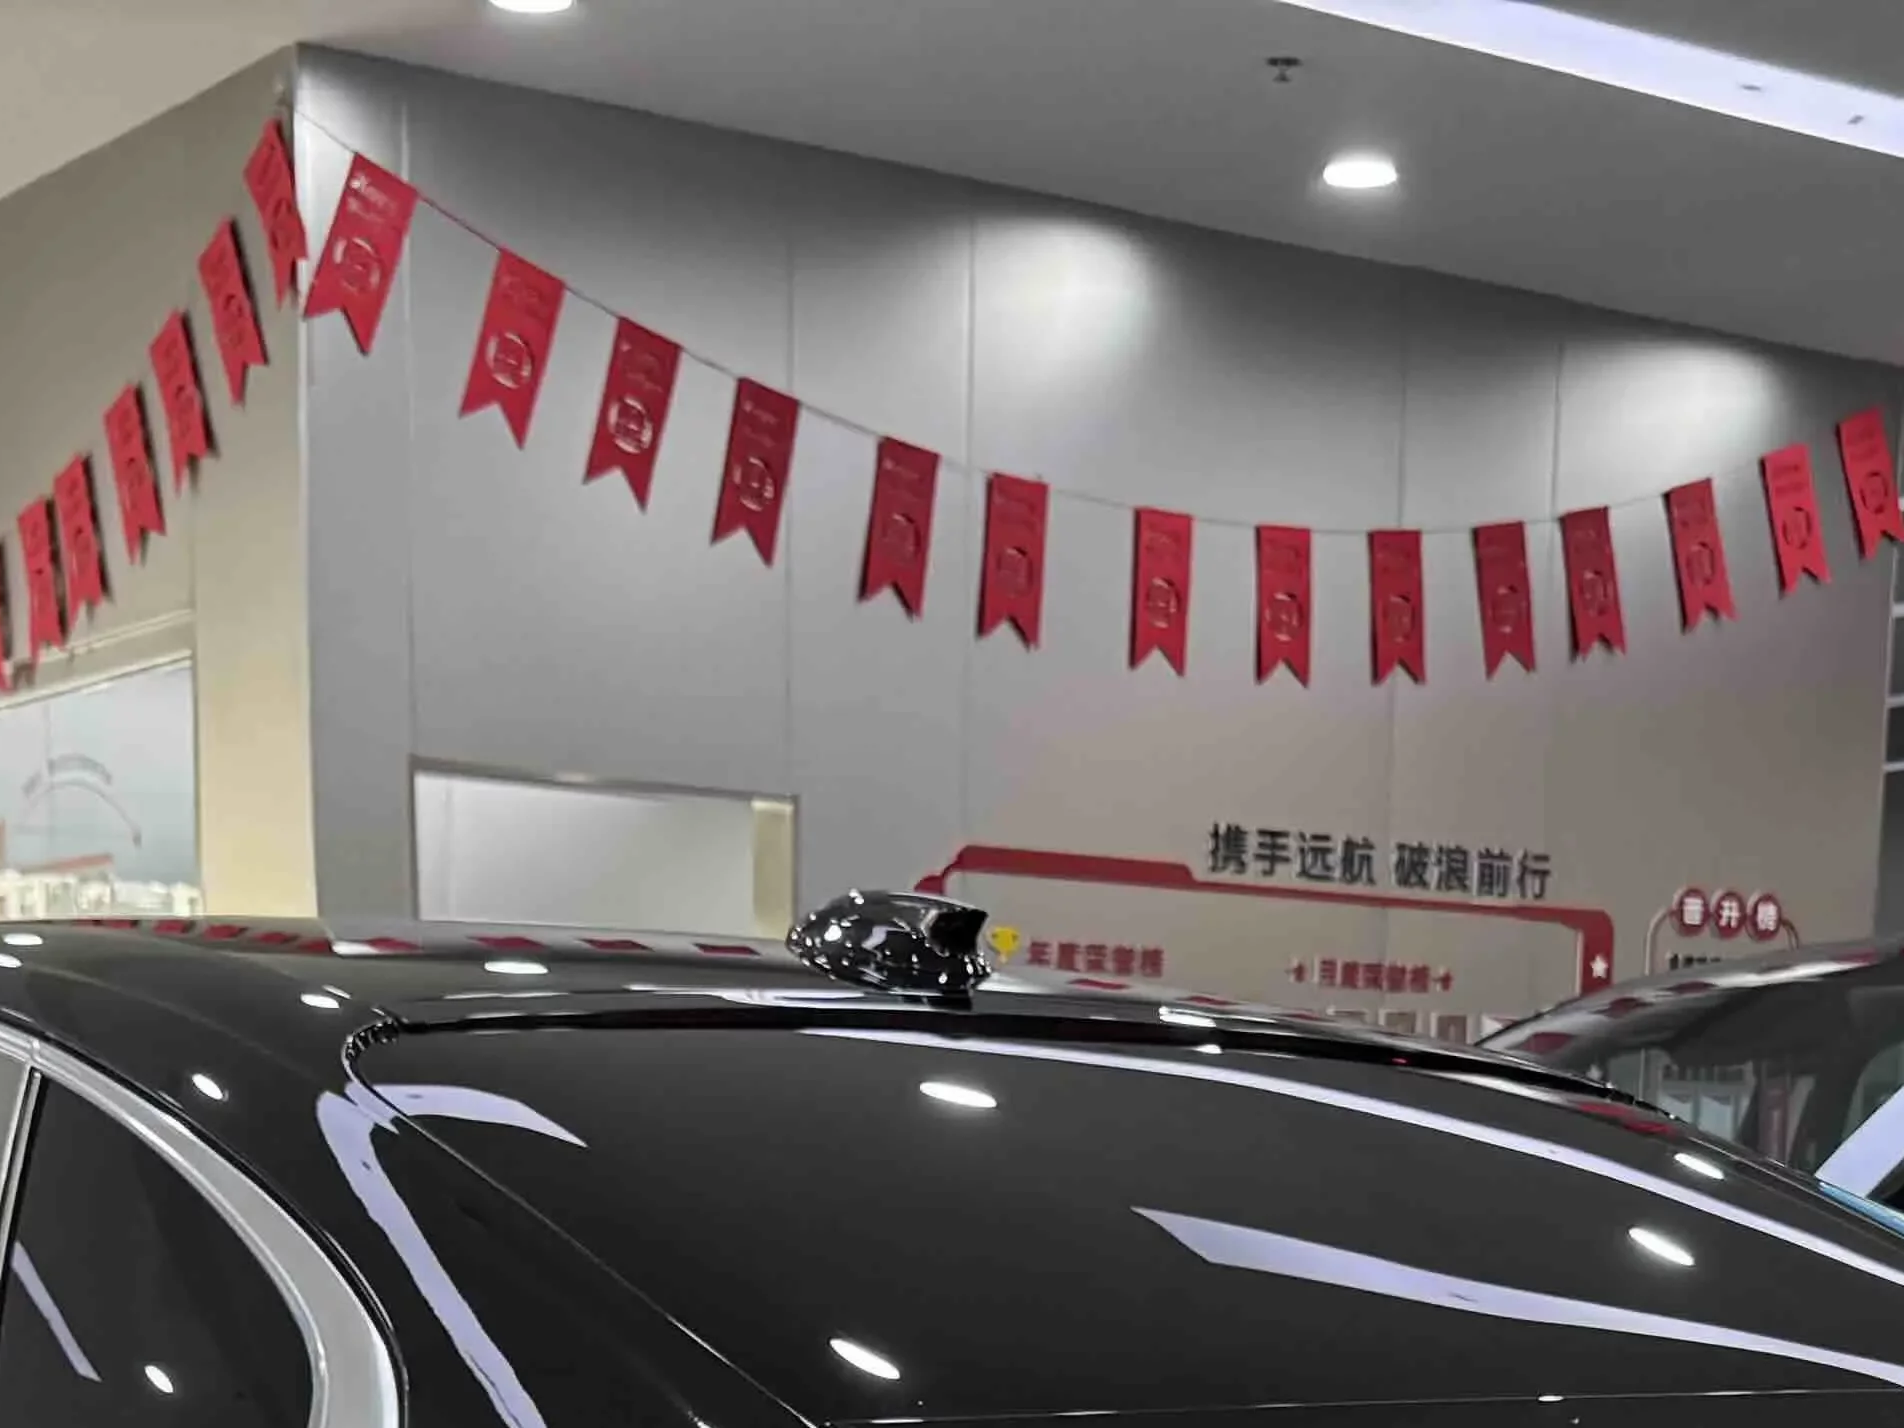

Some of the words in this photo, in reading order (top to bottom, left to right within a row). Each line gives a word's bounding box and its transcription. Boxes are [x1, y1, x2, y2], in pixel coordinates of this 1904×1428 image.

[1209, 821, 1376, 887] 携手远航
[1394, 842, 1552, 900] 破浪前行
